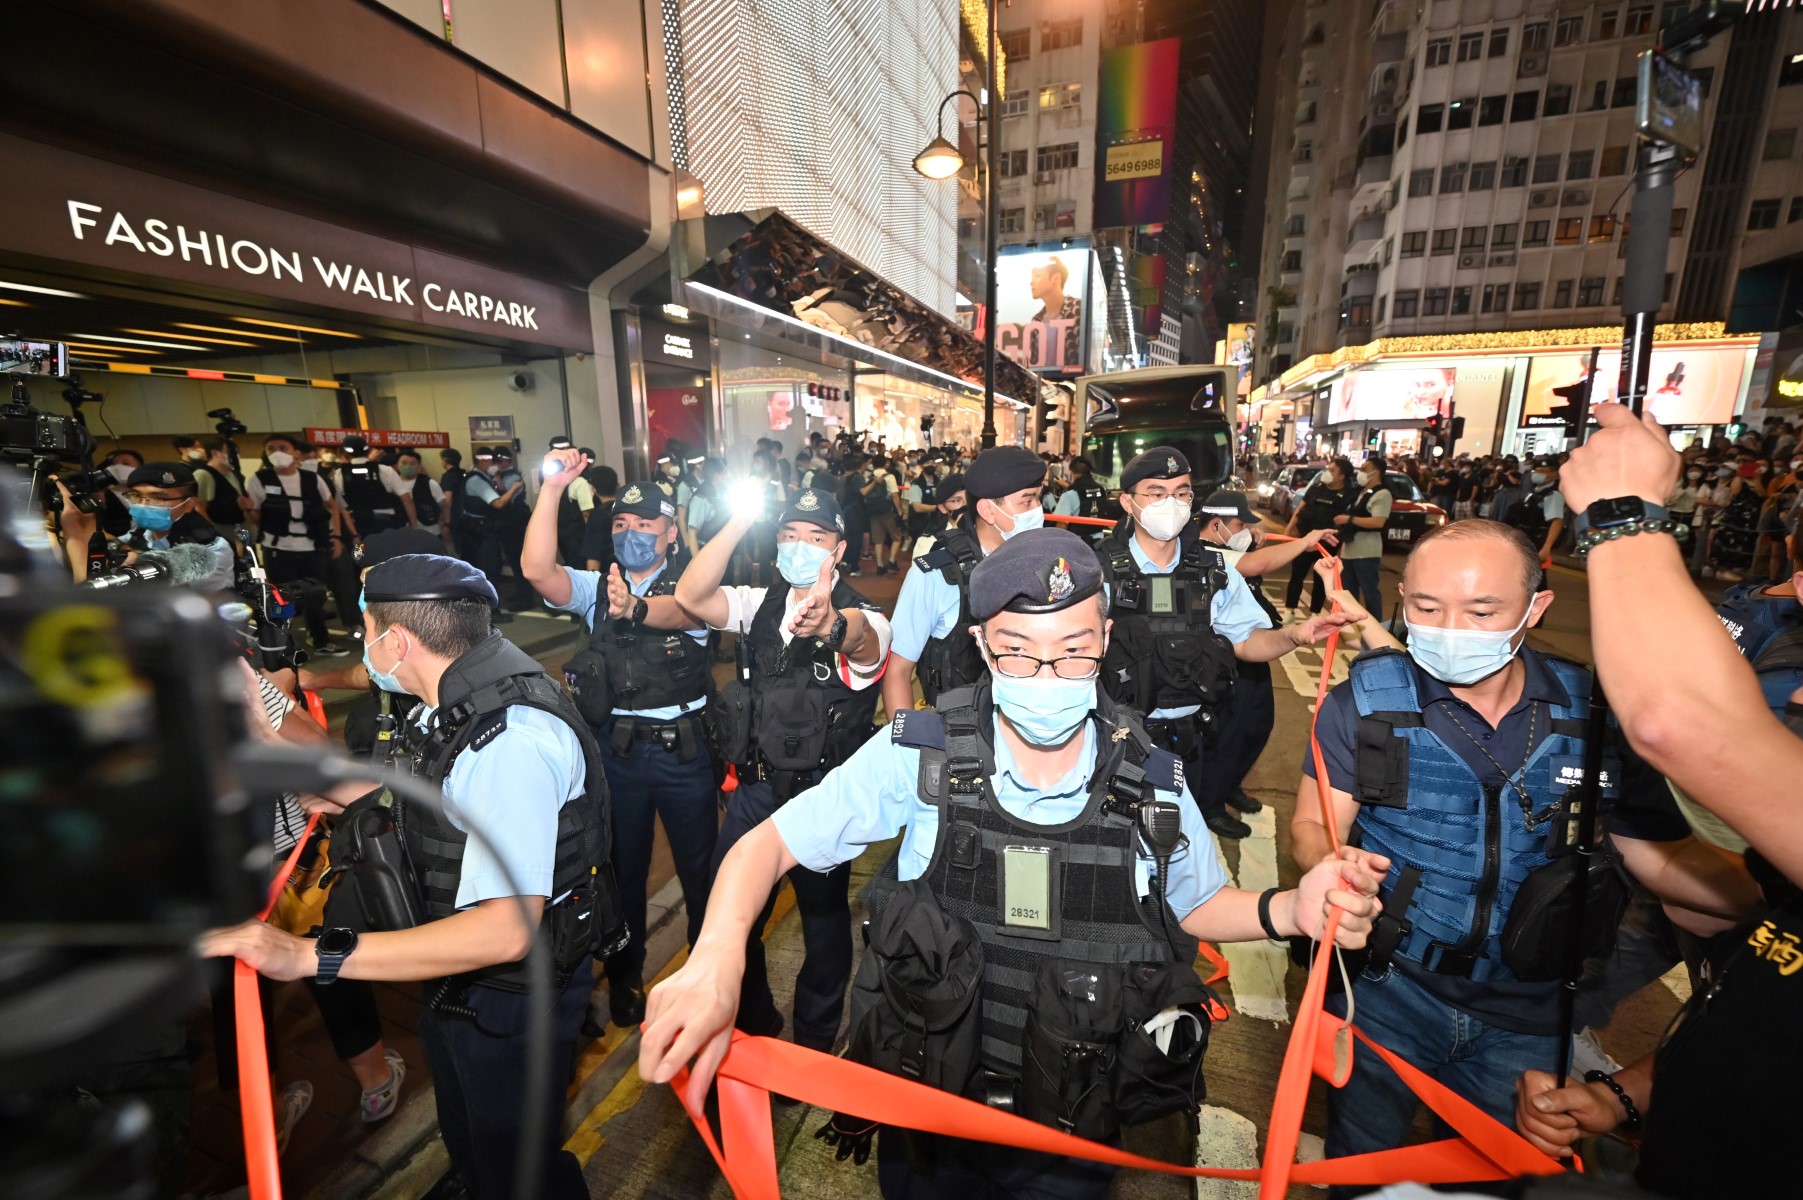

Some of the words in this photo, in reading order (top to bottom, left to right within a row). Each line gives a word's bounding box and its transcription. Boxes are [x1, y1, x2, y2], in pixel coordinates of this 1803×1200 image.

[67, 200, 303, 283] FASHION
[312, 256, 414, 306] WALK
[423, 283, 539, 331] CARPARK
[387, 432, 427, 445] HEADROOM
[428, 433, 444, 445] 1.7M
[893, 712, 906, 738] 28321
[1173, 759, 1184, 788] 28321
[1011, 907, 1039, 920] 28321
